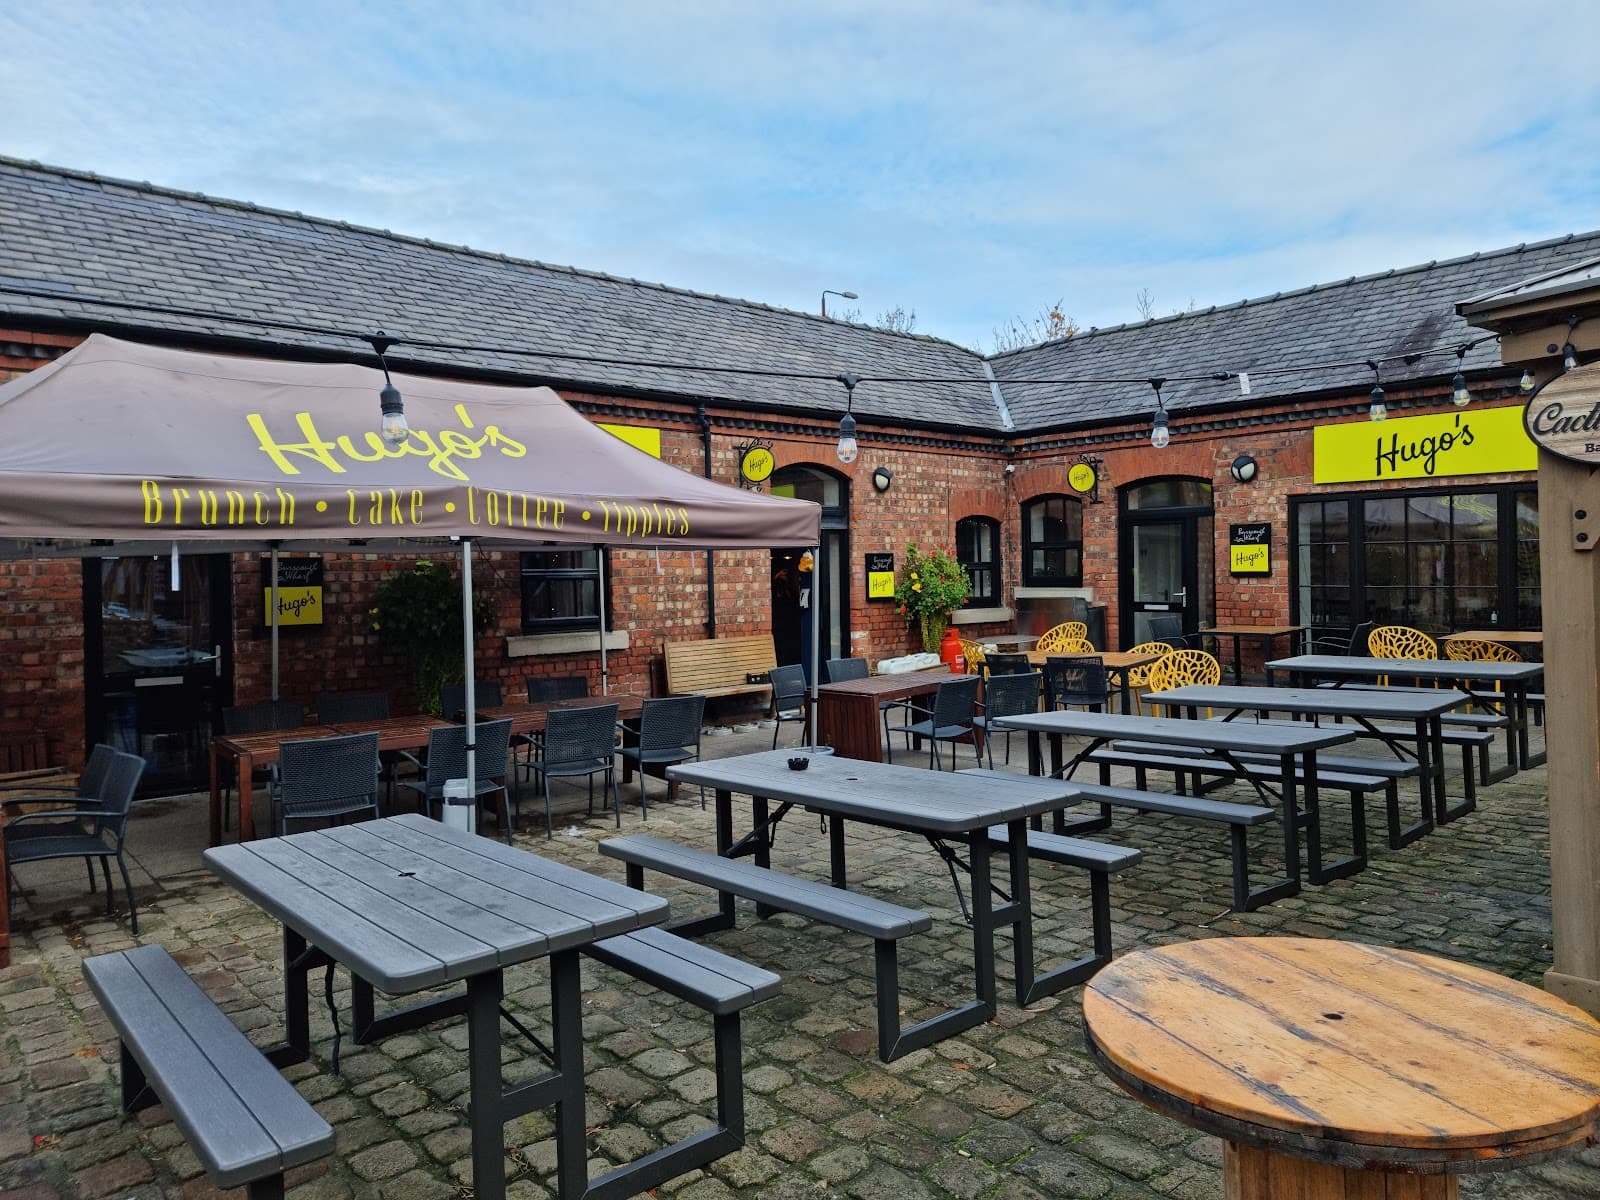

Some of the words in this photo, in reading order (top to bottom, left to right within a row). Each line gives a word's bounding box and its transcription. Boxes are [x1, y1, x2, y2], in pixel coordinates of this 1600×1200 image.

[246, 404, 527, 481] Hugo's
[1375, 414, 1475, 477] Hugo's
[141, 480, 296, 526] Brunch
[346, 488, 424, 526] Cake
[467, 486, 566, 530] Coffee
[599, 500, 690, 538] Tipples
[1236, 547, 1265, 567] Hugo's
